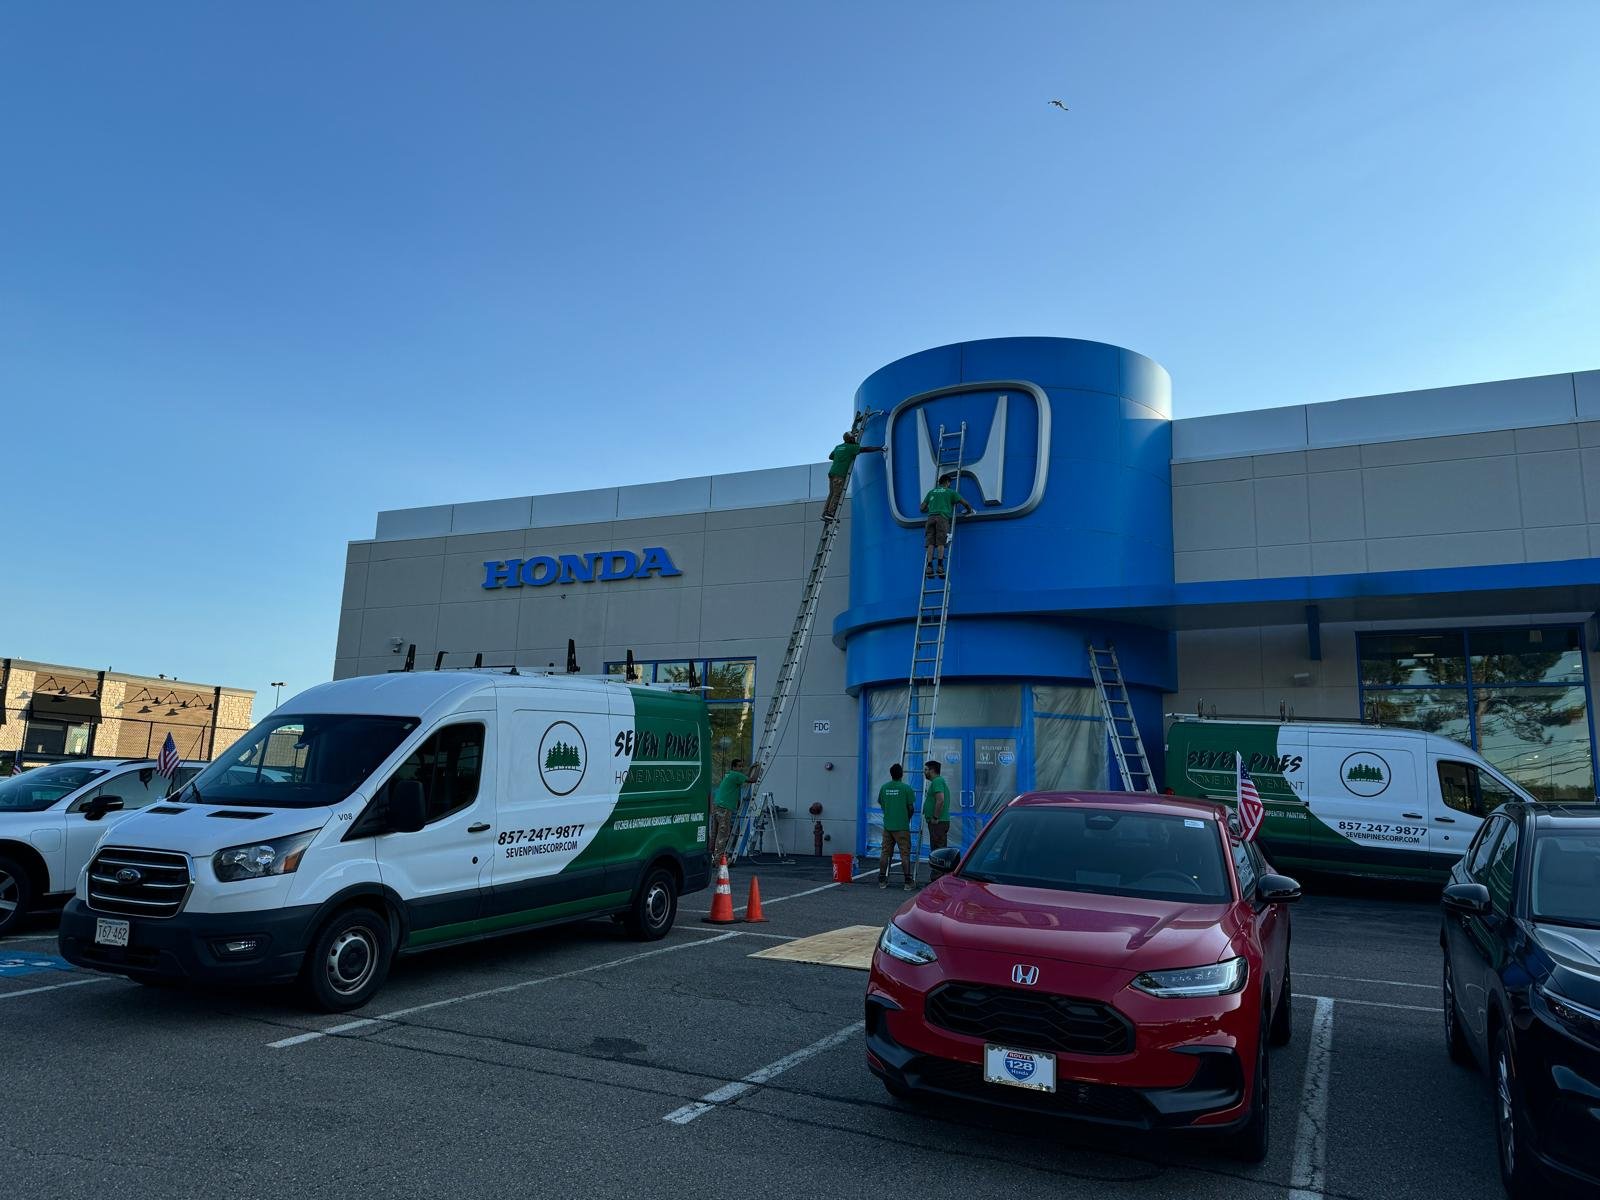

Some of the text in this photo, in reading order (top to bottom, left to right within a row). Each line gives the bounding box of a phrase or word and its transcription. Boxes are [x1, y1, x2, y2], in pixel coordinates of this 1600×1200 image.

[481, 547, 683, 589] HONDA
[814, 722, 829, 731] FDC
[614, 730, 700, 759] SEVEN PINES
[1249, 752, 1303, 773] PINES
[338, 812, 353, 821] V08
[497, 824, 585, 846] 857-247-9877
[1338, 821, 1428, 837] 857-247-9877
[1345, 831, 1420, 844] SEVENPINESCORP.COM
[505, 841, 578, 858] SEVENPINESCORP.COM
[1009, 1052, 1031, 1060] ROUTE
[1006, 1060, 1033, 1071] 128
